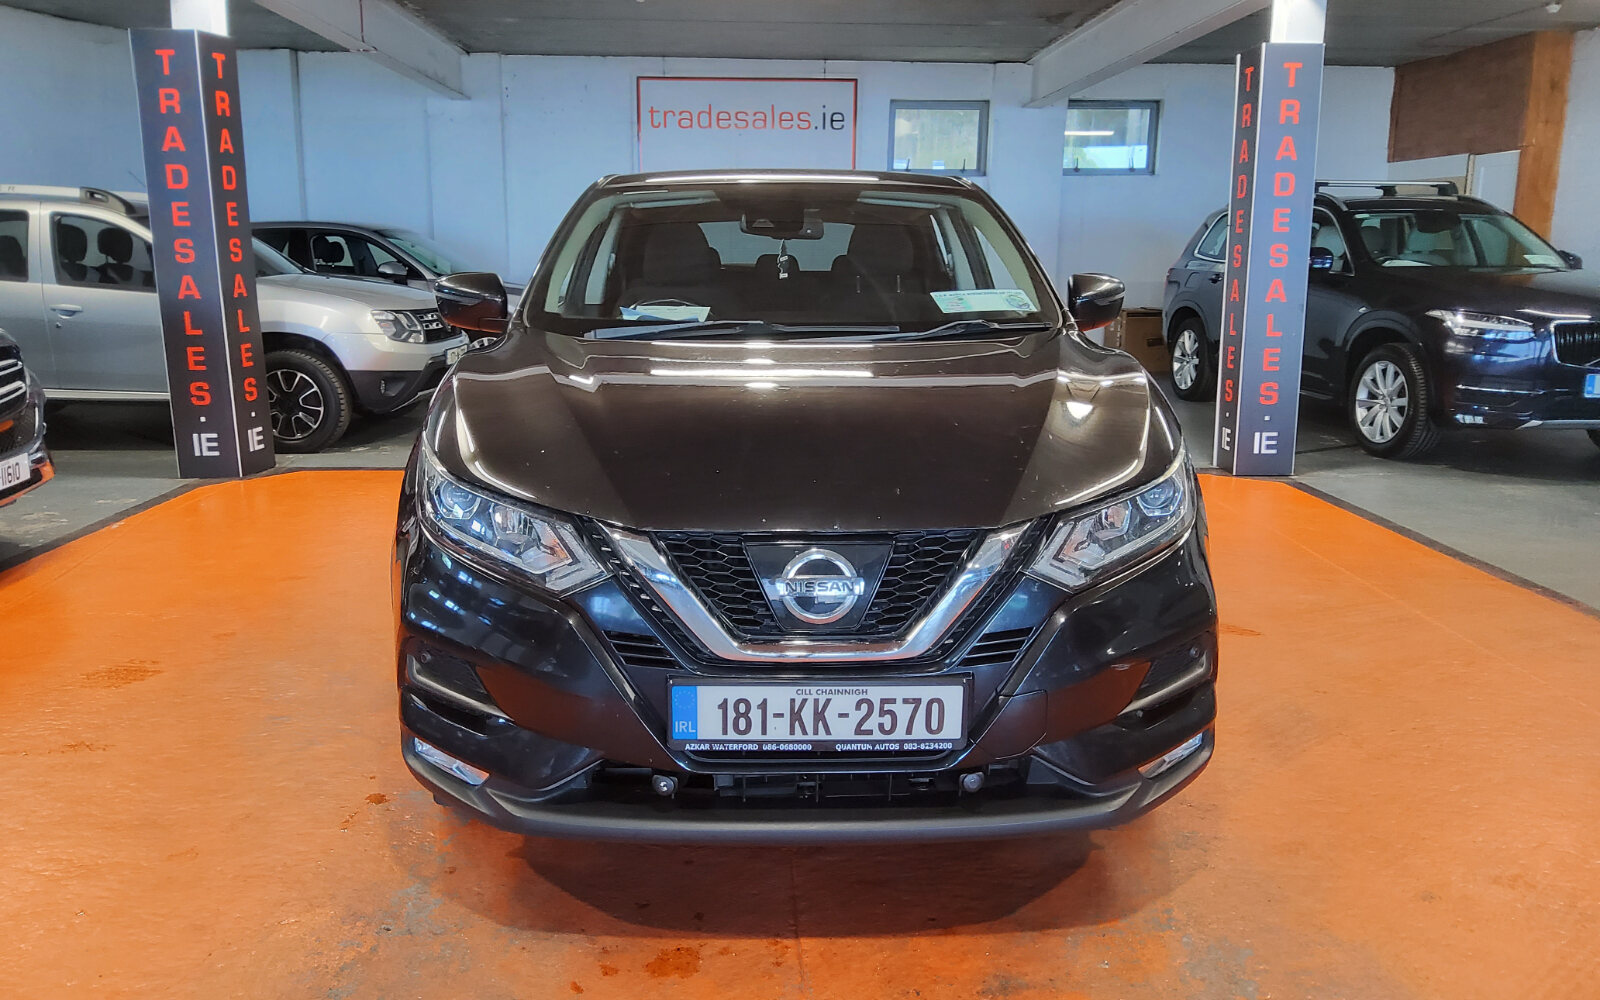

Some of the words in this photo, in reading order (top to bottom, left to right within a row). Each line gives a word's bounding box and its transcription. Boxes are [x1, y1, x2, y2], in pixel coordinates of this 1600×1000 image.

[648, 104, 845, 131] tradesales.ie
[785, 581, 854, 593] NISSAN
[796, 688, 813, 696] CILL
[815, 688, 868, 696] CHAINNIGH
[717, 698, 945, 736] 181-KK-2570
[674, 720, 696, 733] IRL
[835, 743, 872, 751] QUANTUM
